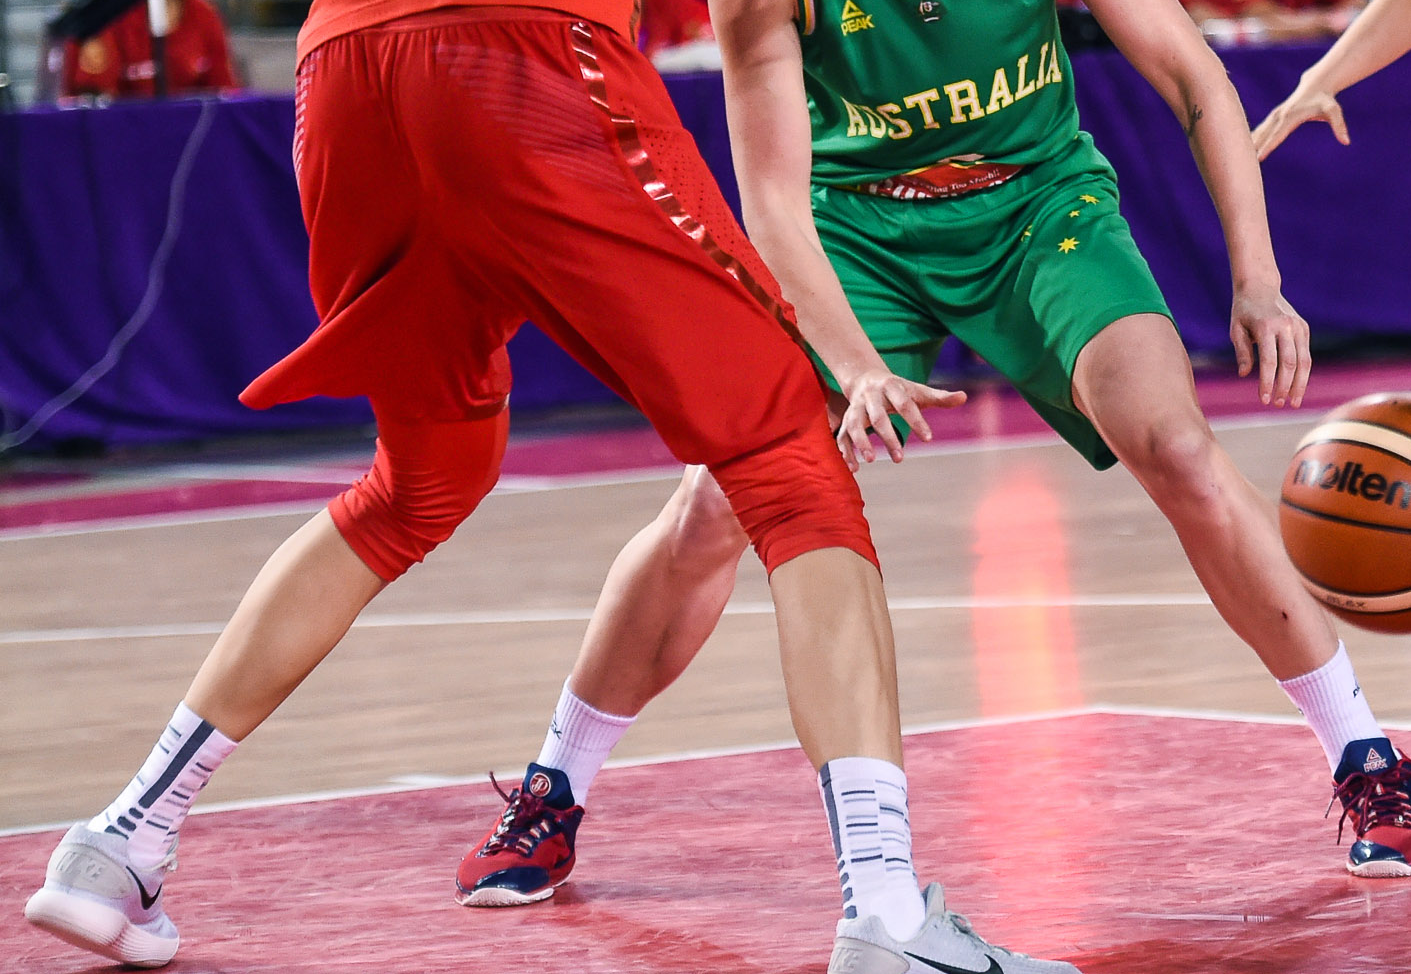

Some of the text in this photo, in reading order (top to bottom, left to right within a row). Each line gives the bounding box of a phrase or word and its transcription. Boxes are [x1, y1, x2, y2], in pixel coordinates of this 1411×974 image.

[841, 14, 875, 36] PEAK
[840, 39, 1062, 140] AUSTRALIA
[1362, 758, 1388, 773] PEAK
